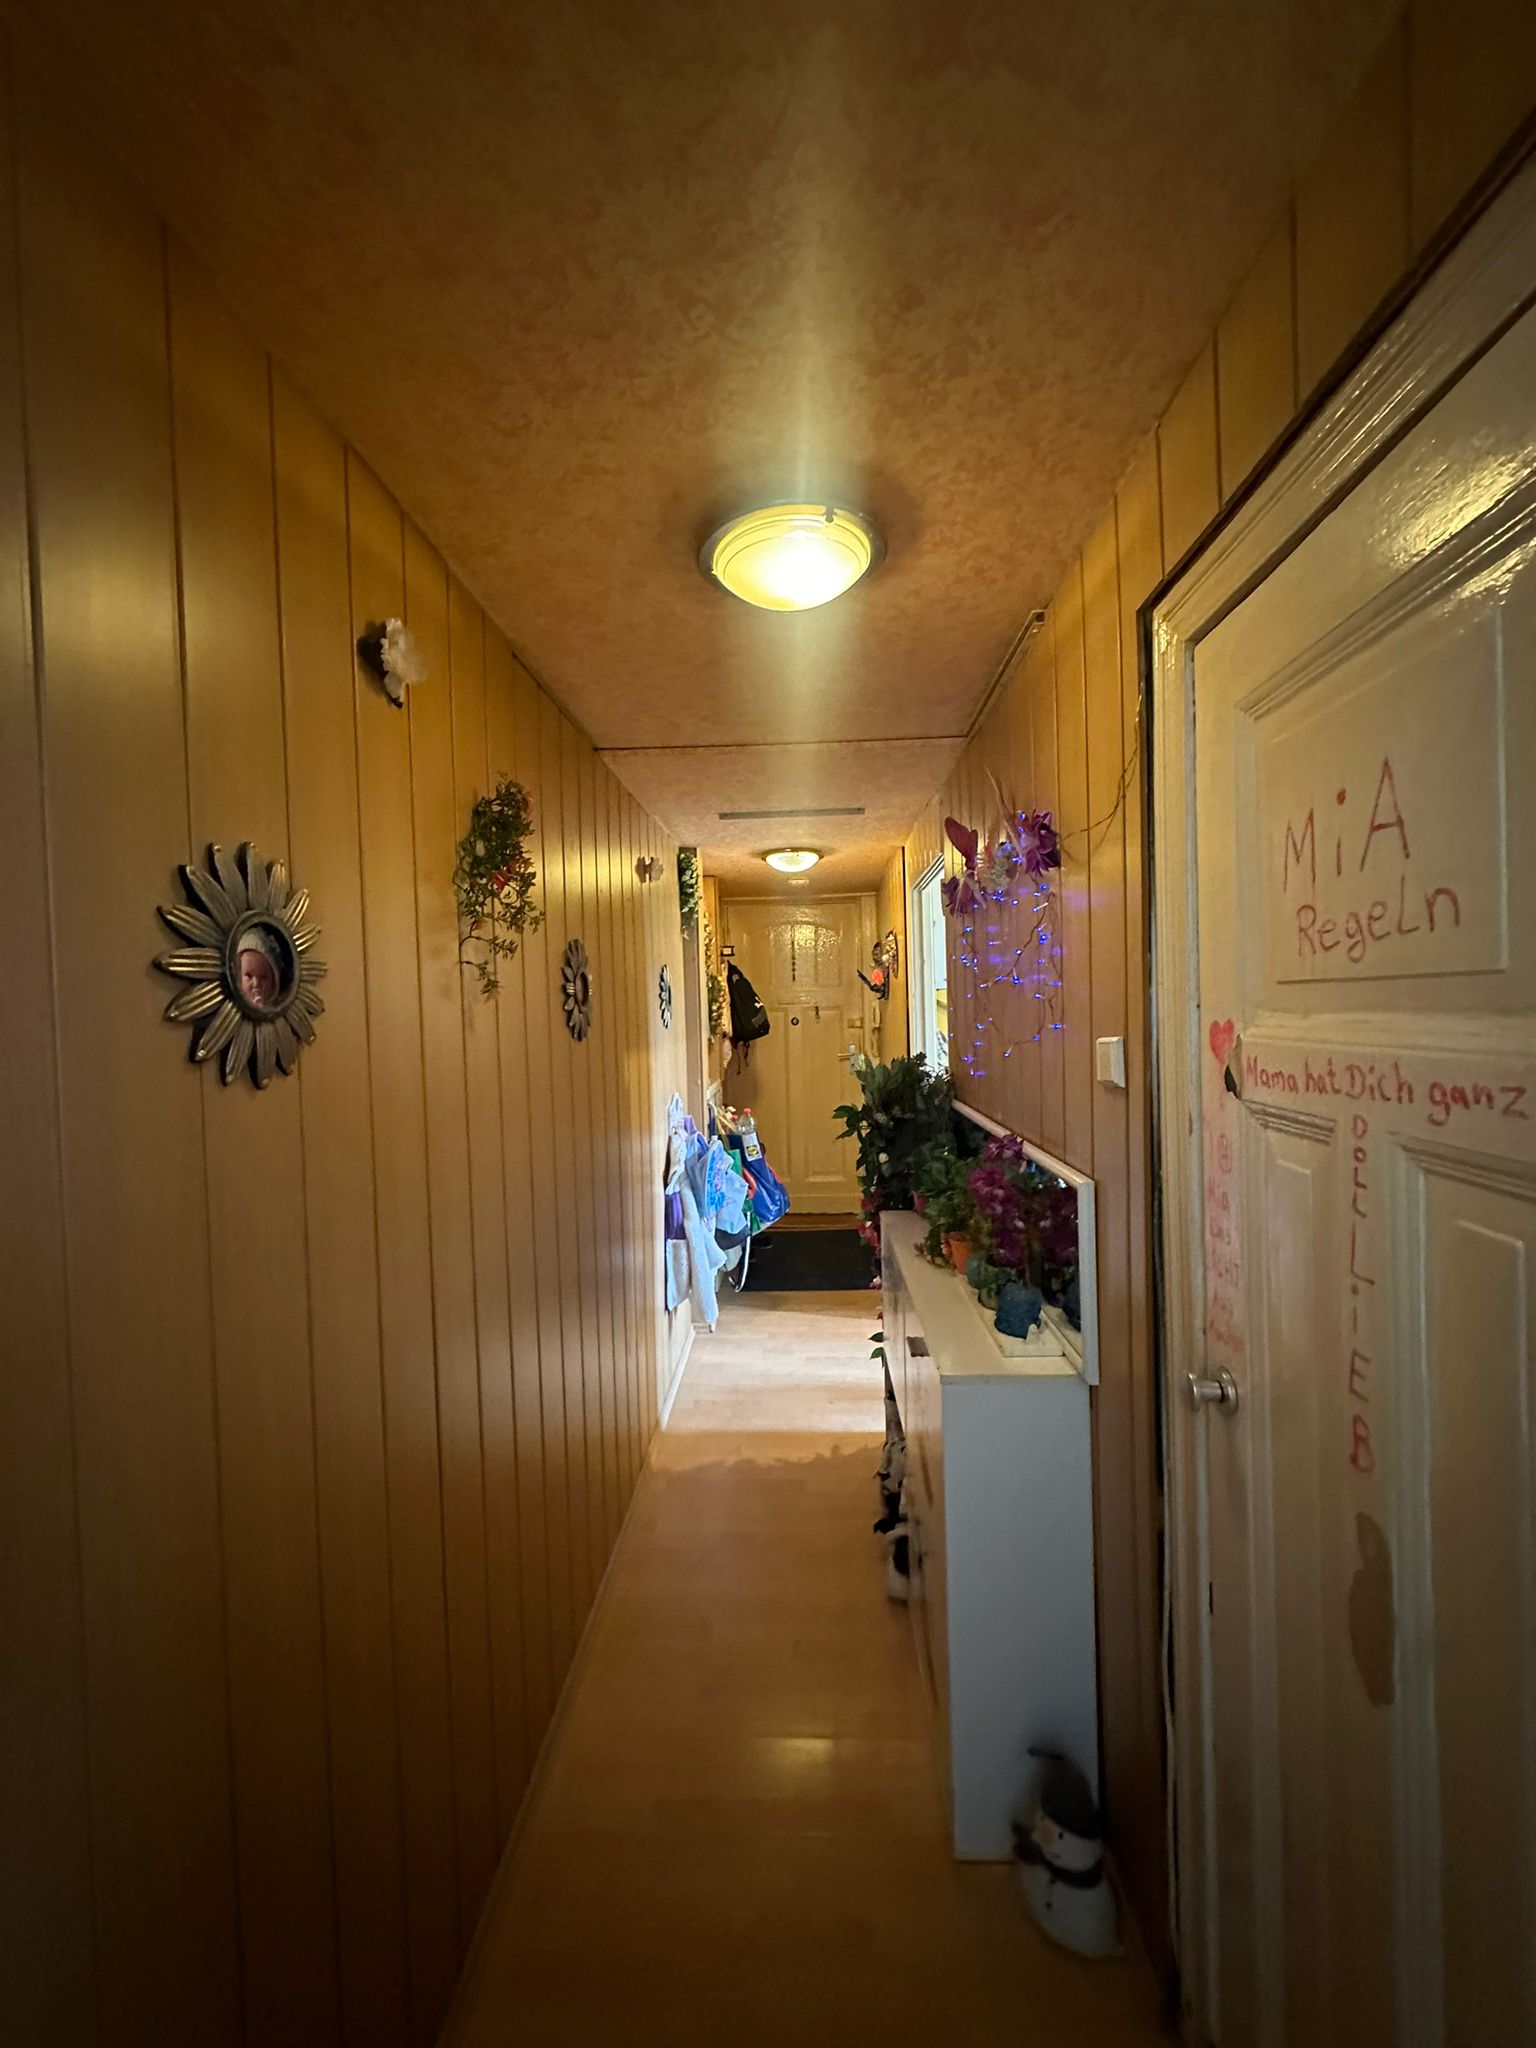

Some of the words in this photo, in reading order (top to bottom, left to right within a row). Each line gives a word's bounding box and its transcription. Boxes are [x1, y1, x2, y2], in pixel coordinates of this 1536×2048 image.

[1245, 1054, 1299, 1096] Mama
[1304, 1057, 1342, 1095] hat
[1345, 1060, 1414, 1105] Dich
[1427, 1082, 1529, 1128] ganz
